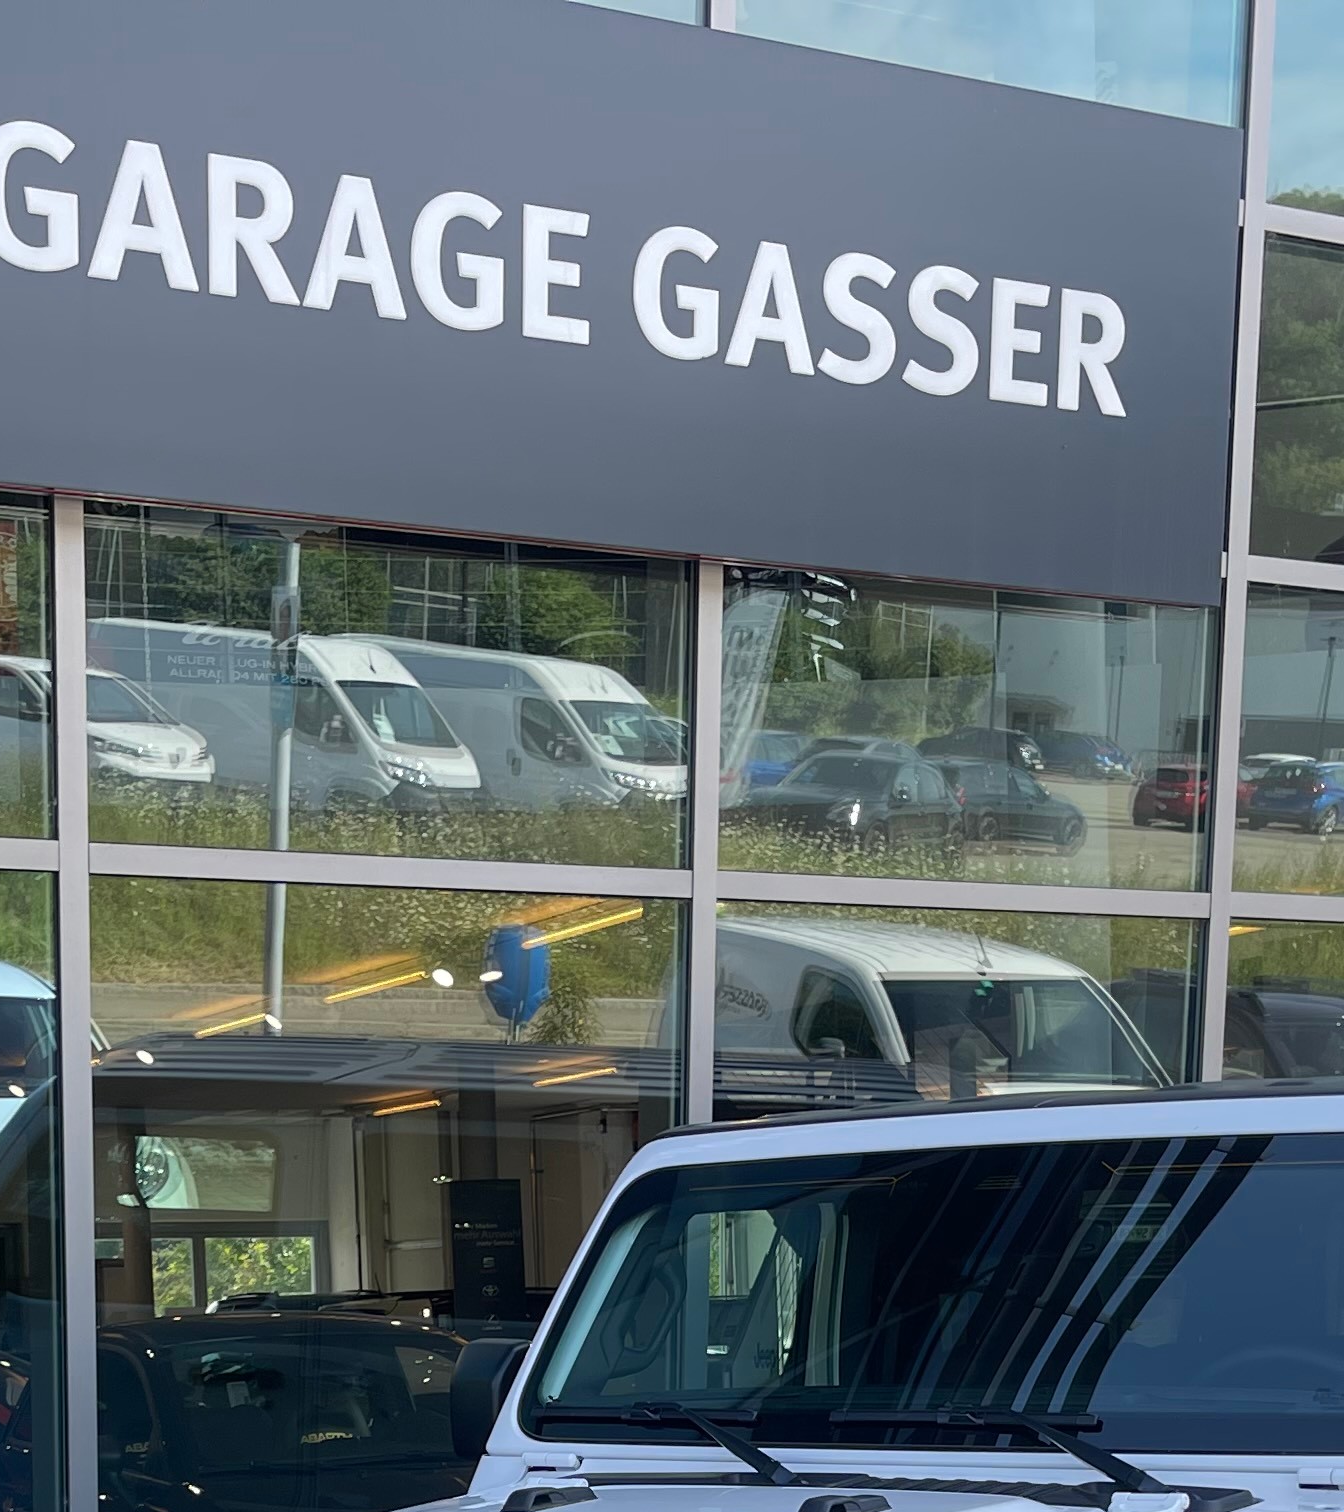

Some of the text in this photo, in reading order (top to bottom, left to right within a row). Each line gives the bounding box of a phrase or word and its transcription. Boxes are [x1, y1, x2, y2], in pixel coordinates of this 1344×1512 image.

[632, 225, 1126, 417] GASSER
[167, 655, 216, 666] NEUER
[221, 656, 276, 670] UG-IN
